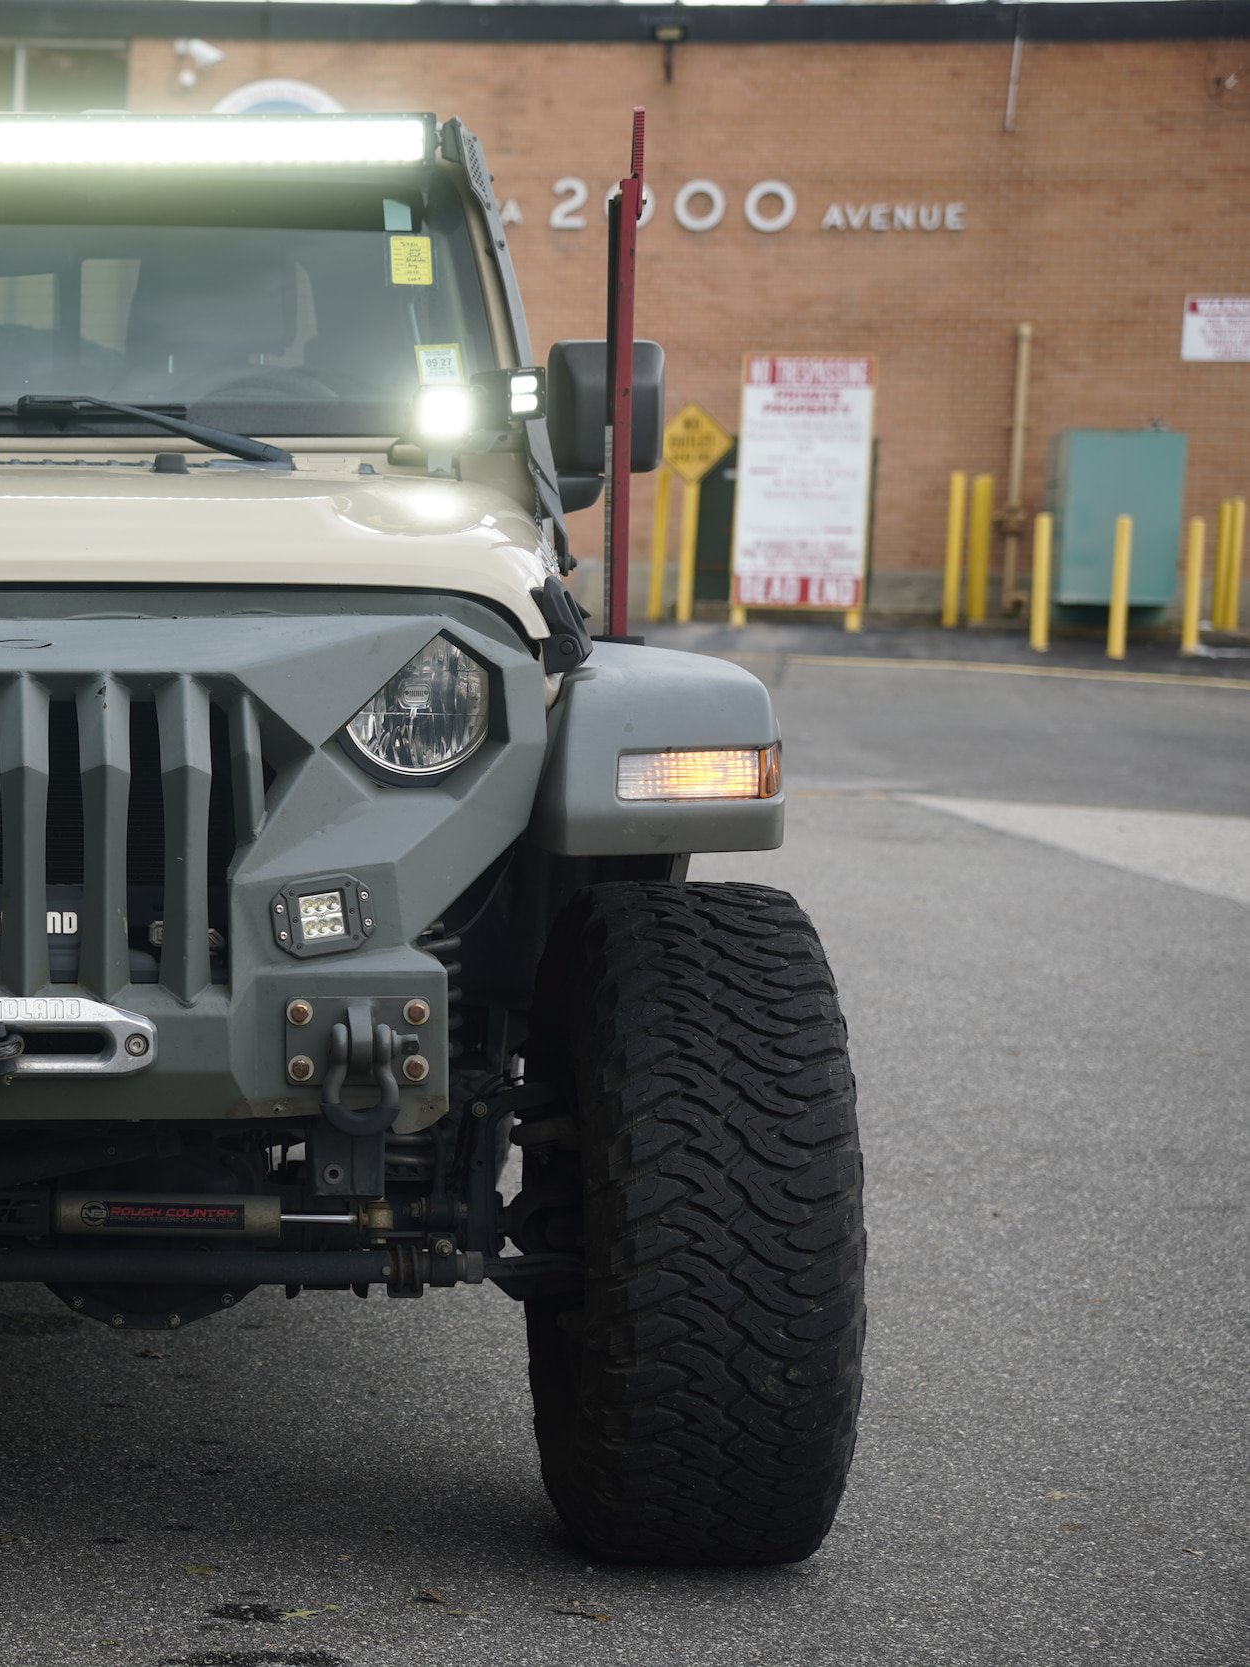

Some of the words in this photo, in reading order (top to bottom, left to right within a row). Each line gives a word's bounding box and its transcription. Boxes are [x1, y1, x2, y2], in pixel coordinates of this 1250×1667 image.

[820, 202, 967, 232] AVENUE
[110, 1206, 162, 1217] ROUGH
[165, 1207, 239, 1218] COUNTRY
